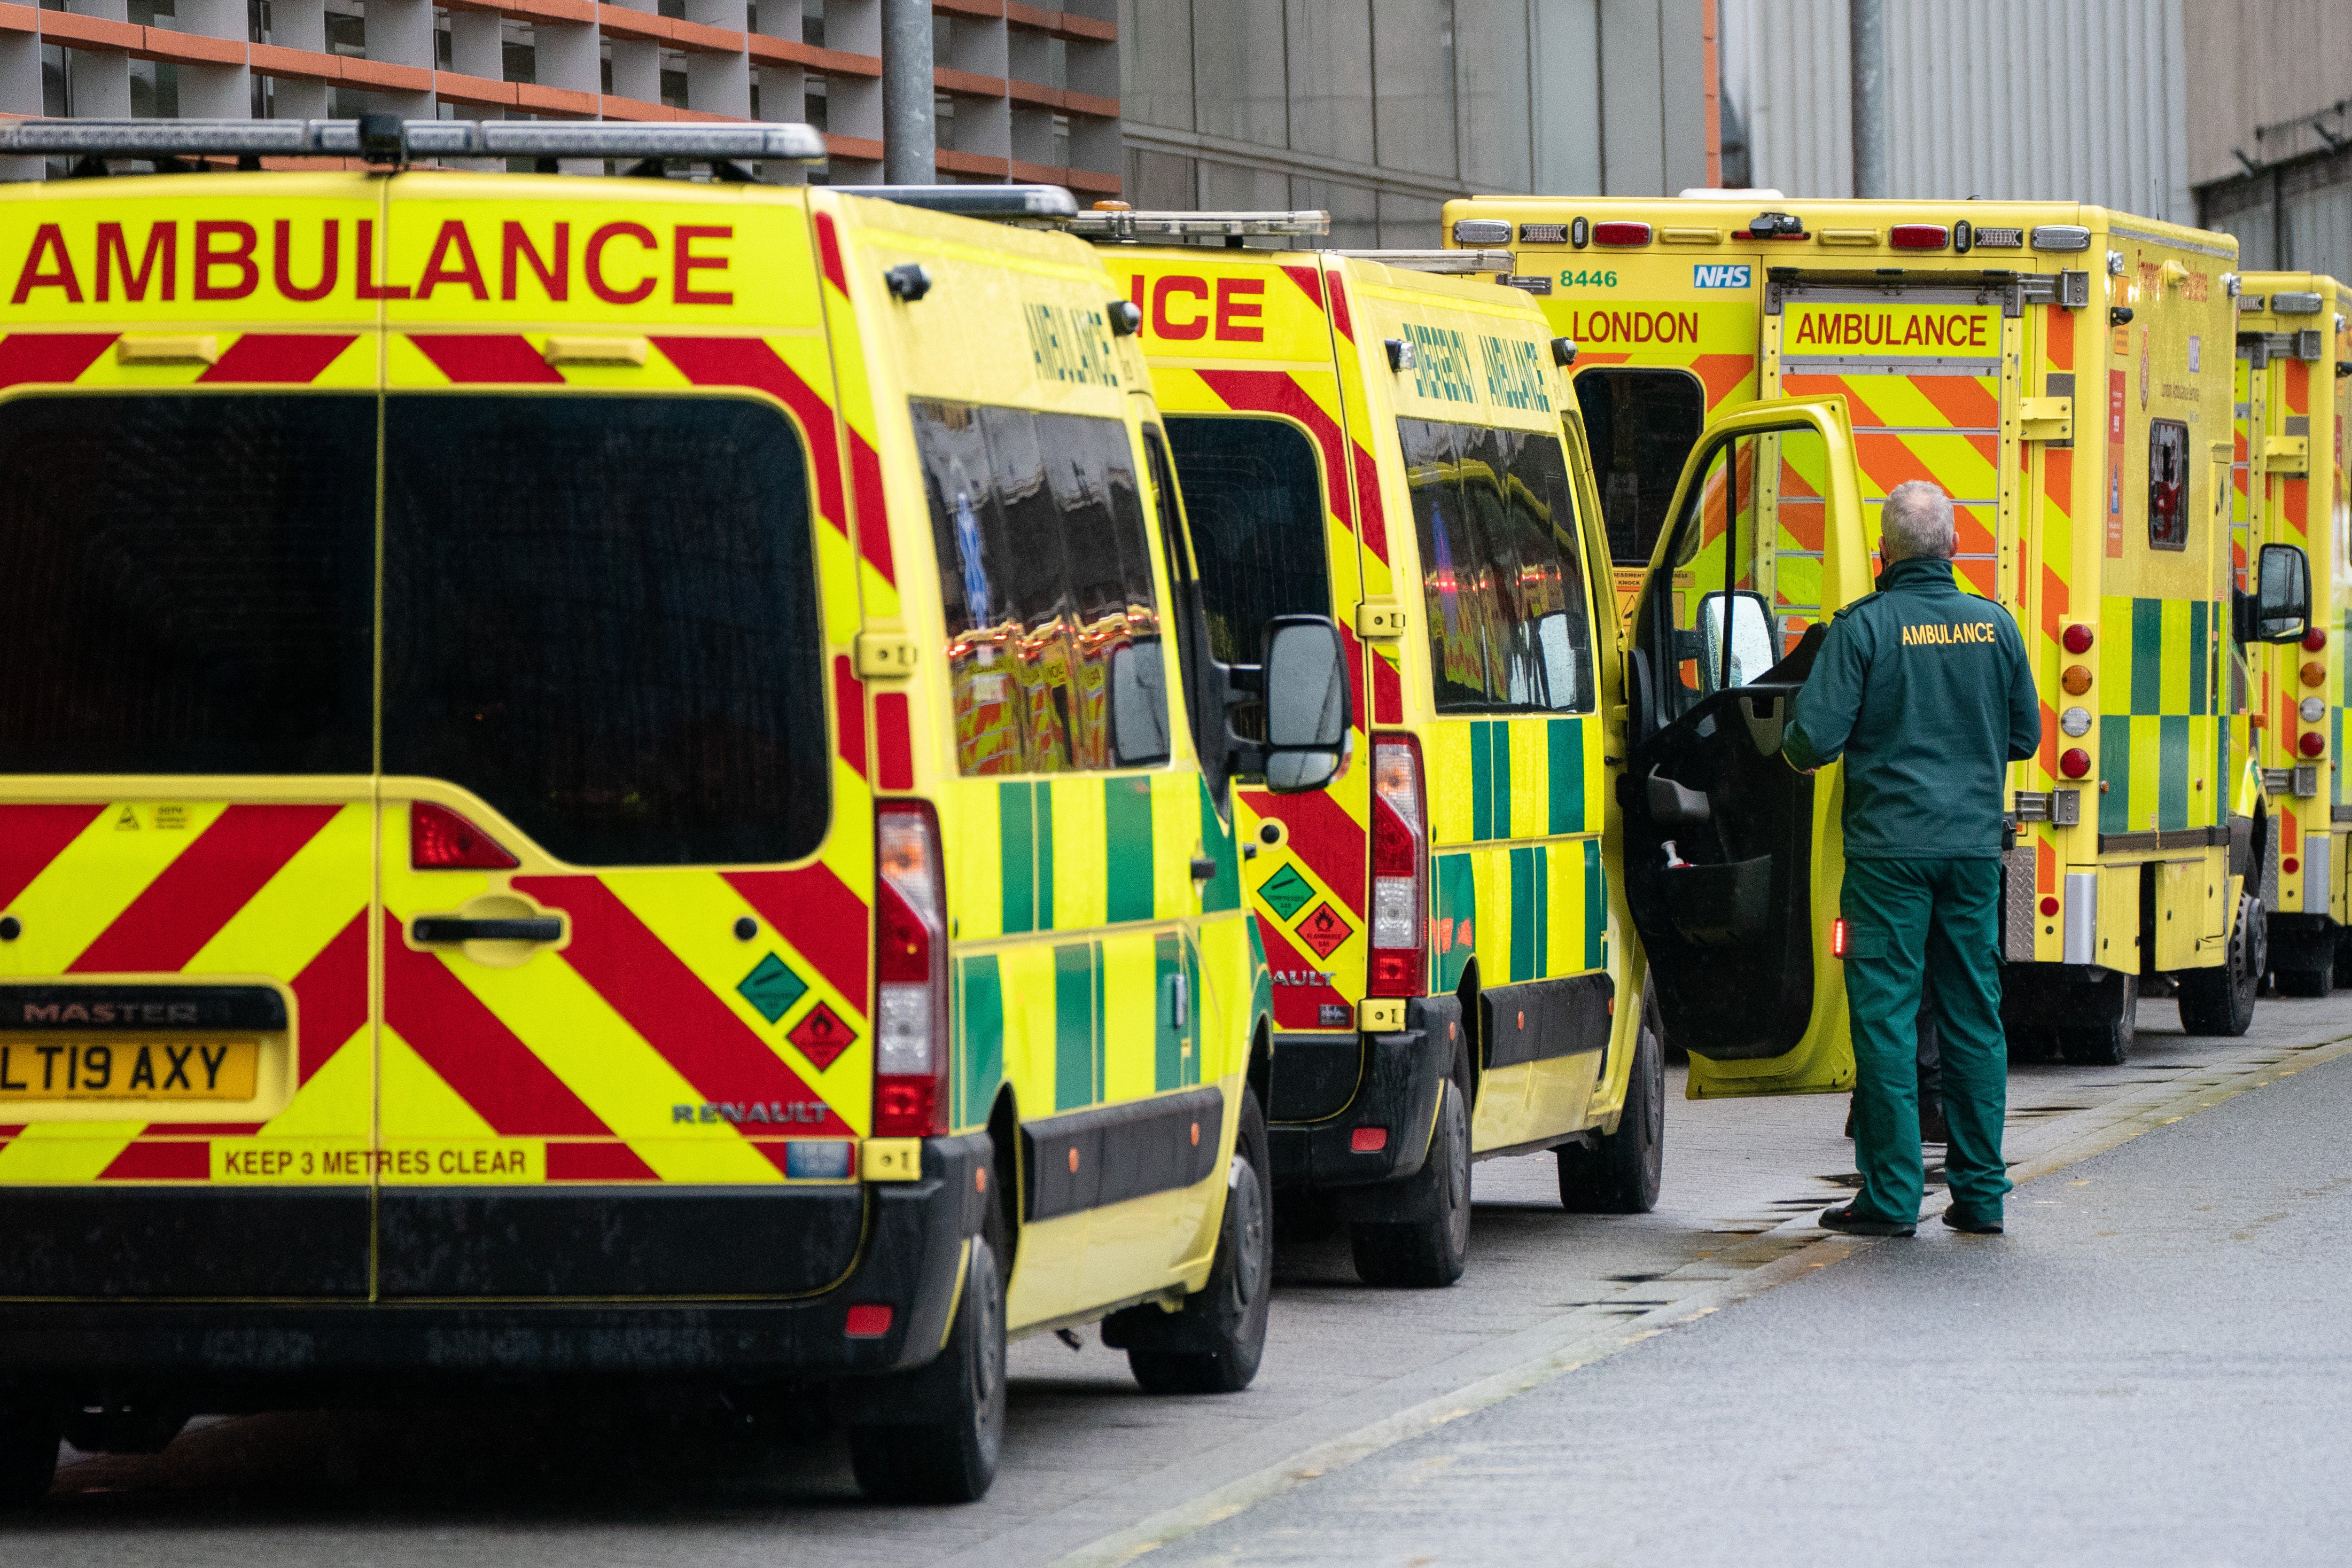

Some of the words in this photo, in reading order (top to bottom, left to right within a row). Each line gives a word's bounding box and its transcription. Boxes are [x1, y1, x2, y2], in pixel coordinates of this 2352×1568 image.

[11, 219, 734, 305] AMBULANCE
[1560, 270, 1618, 287] 8446
[1696, 266, 1750, 288] NHS
[1572, 310, 1699, 343] LONDON
[1796, 313, 1987, 346] AMBULANCE
[1403, 323, 1478, 404] EMERGENCY
[1478, 334, 1551, 412] AMBULANCE
[1903, 622, 1995, 645] AMBULANCE
[23, 1002, 198, 1024] MASTER
[1, 1046, 112, 1091] LT19
[130, 1046, 228, 1091] AXY
[672, 1101, 831, 1125] RENAULT
[225, 1150, 292, 1175] KEEP
[301, 1151, 314, 1175] 3
[323, 1151, 429, 1175] METRES
[438, 1150, 526, 1174] CLEAR
